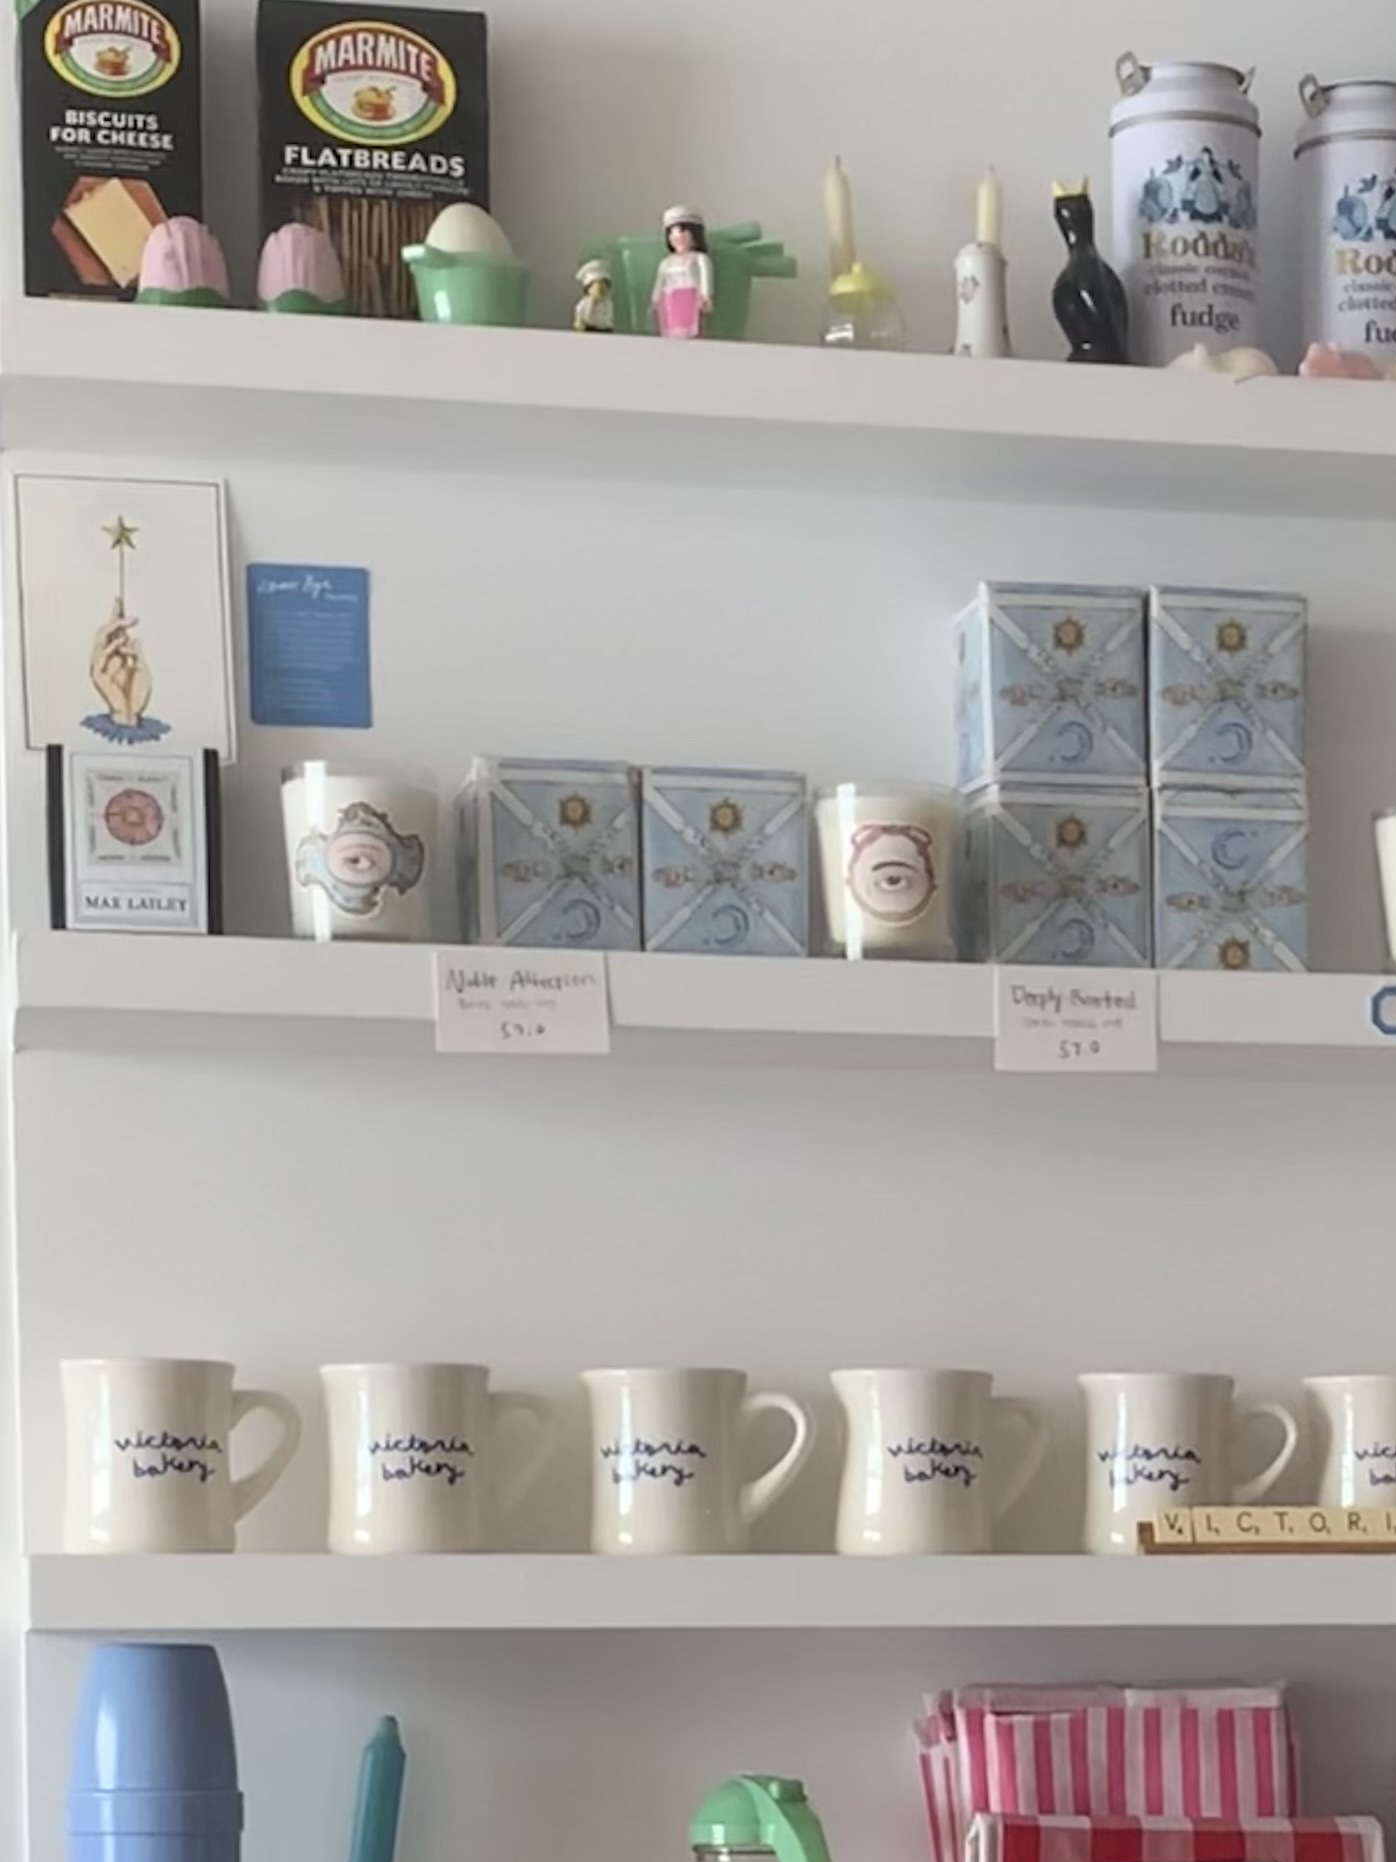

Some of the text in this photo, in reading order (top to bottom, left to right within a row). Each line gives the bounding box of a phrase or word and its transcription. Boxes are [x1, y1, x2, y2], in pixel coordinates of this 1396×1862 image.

[63, 3, 164, 45] MARMITE
[314, 32, 436, 81] MARMITE
[64, 109, 159, 131] BISCUITS
[50, 126, 174, 150] FOR CHEESE
[284, 145, 465, 177] FLATBREADS
[1171, 303, 1239, 334] fudge
[115, 1430, 222, 1453] victoria
[368, 1434, 474, 1456] victoria
[887, 1437, 984, 1459] victoria
[133, 1454, 215, 1483] bakery
[383, 1455, 465, 1485] bakery
[904, 1458, 977, 1487] bakery
